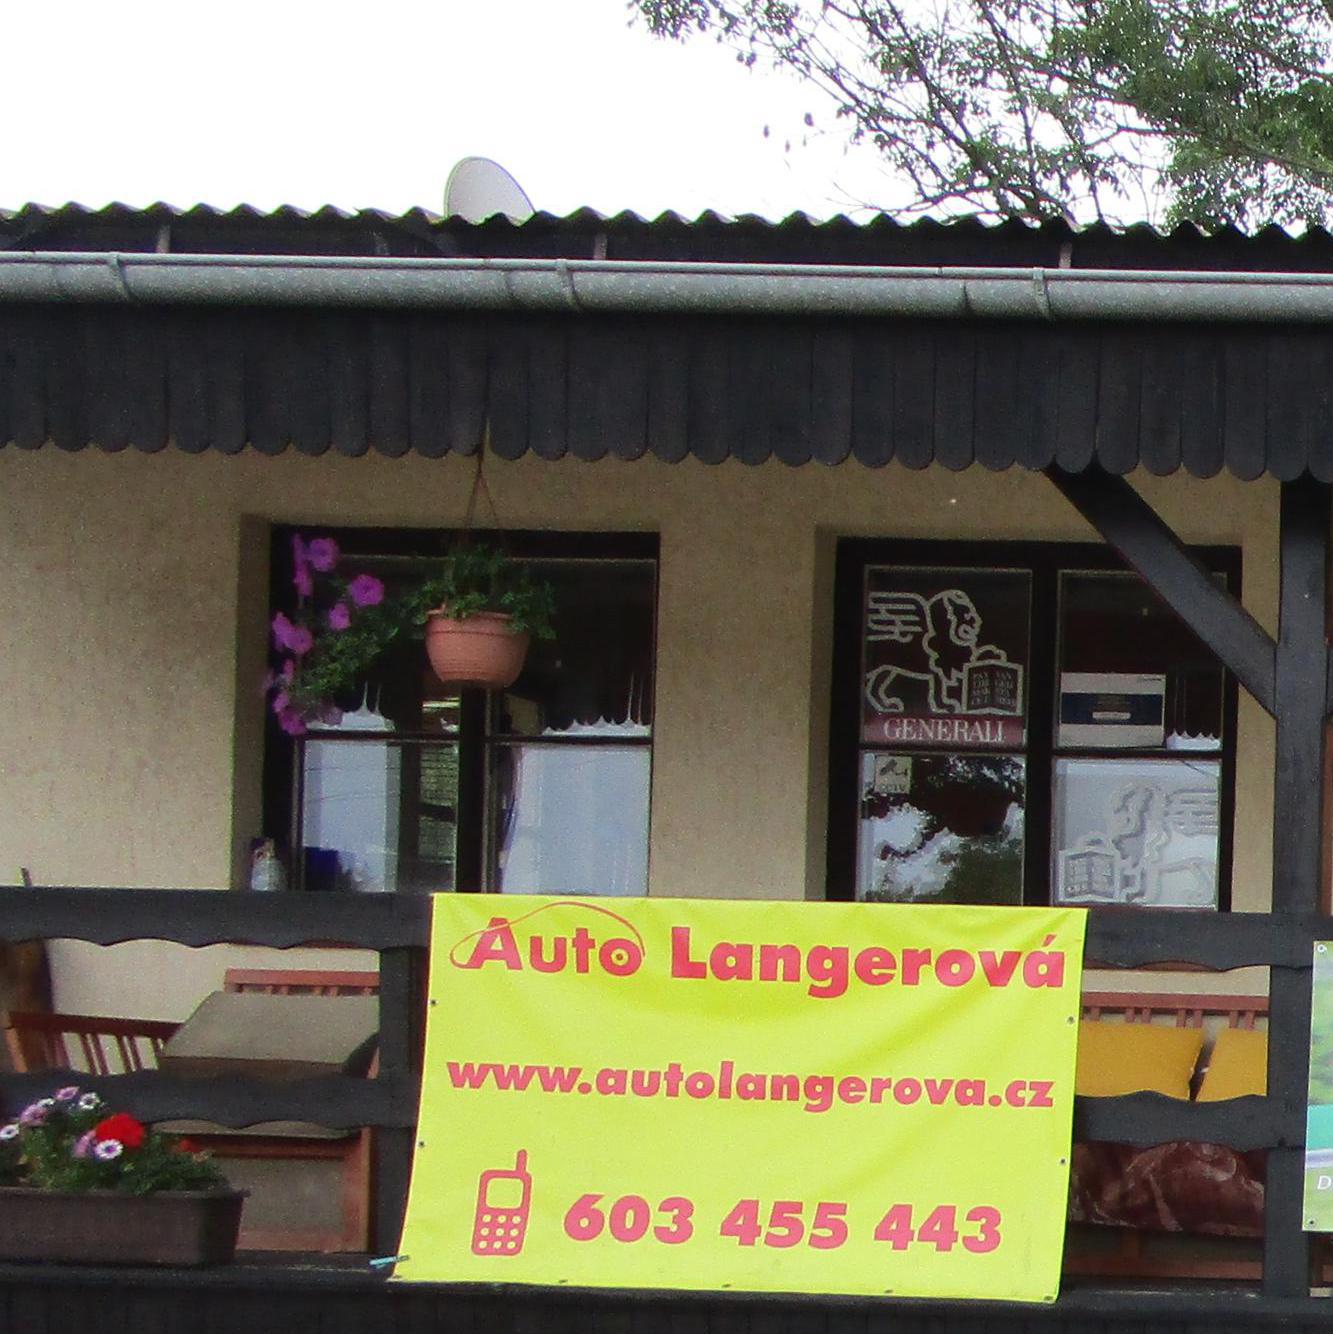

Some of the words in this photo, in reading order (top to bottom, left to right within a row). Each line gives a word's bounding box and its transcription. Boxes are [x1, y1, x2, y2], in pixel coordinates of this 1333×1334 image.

[883, 718, 1005, 742] GENERALI
[463, 916, 643, 977] Auto
[671, 926, 1065, 999] Langerová
[446, 1060, 1055, 1114] www.autolangerova.cz
[563, 1194, 694, 1244] 603
[719, 1199, 848, 1250] 455
[874, 1204, 1001, 1253] 443
